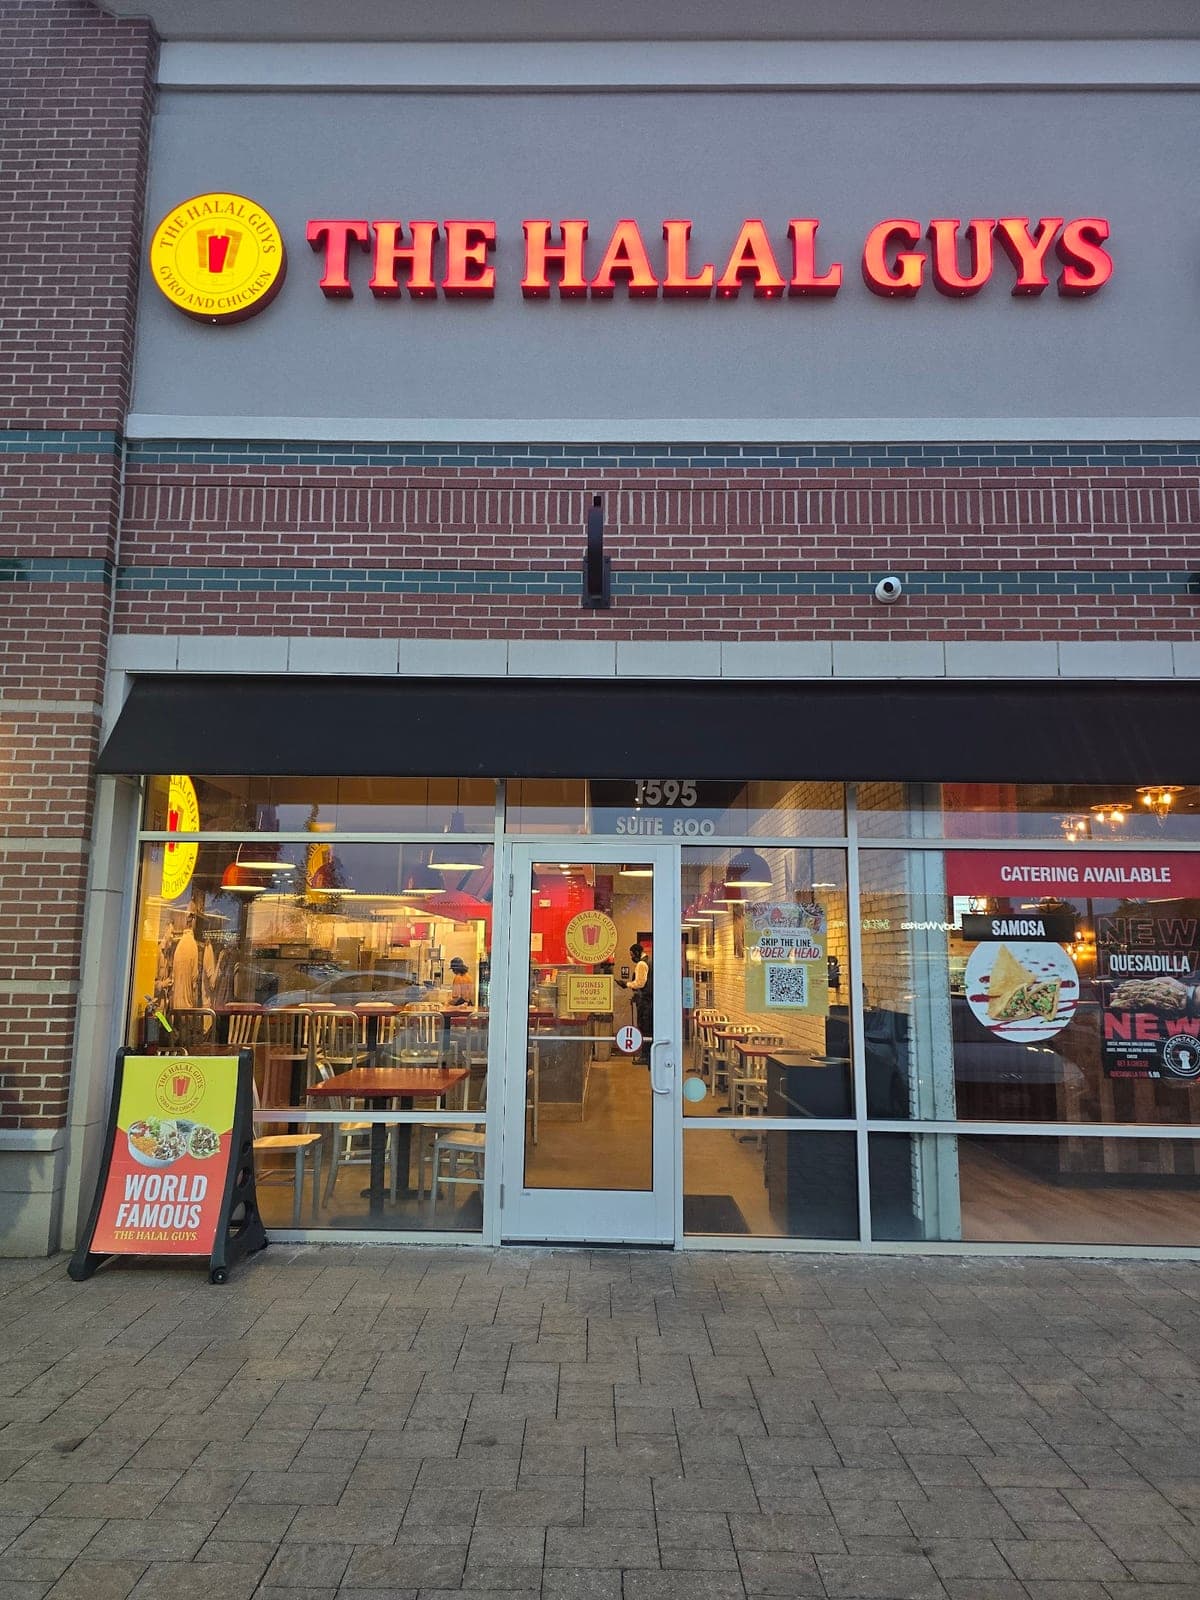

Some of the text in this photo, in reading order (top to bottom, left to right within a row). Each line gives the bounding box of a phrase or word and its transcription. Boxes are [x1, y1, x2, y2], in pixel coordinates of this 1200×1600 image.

[160, 199, 276, 254] THE HALAL GUYS
[306, 217, 1113, 297] THE HALAL GUYS
[159, 264, 272, 308] GYRO AND CHICKEN
[634, 779, 698, 807] 1595
[615, 816, 716, 836] SUITE 800
[1000, 866, 1172, 883] CATERING AVAILABLE
[991, 920, 1046, 936] SAMOSA
[1097, 917, 1197, 946] NEW
[760, 937, 812, 948] SKIP THE LINE
[1109, 954, 1191, 973] QUESADILLA
[576, 981, 604, 989] BUSINESS
[1104, 1012, 1200, 1040] NEW
[157, 1072, 170, 1089] THE
[124, 1174, 208, 1202] WORLD
[115, 1203, 202, 1229] FAMOUS
[114, 1230, 135, 1240] THE
[135, 1231, 169, 1241] HALAL
